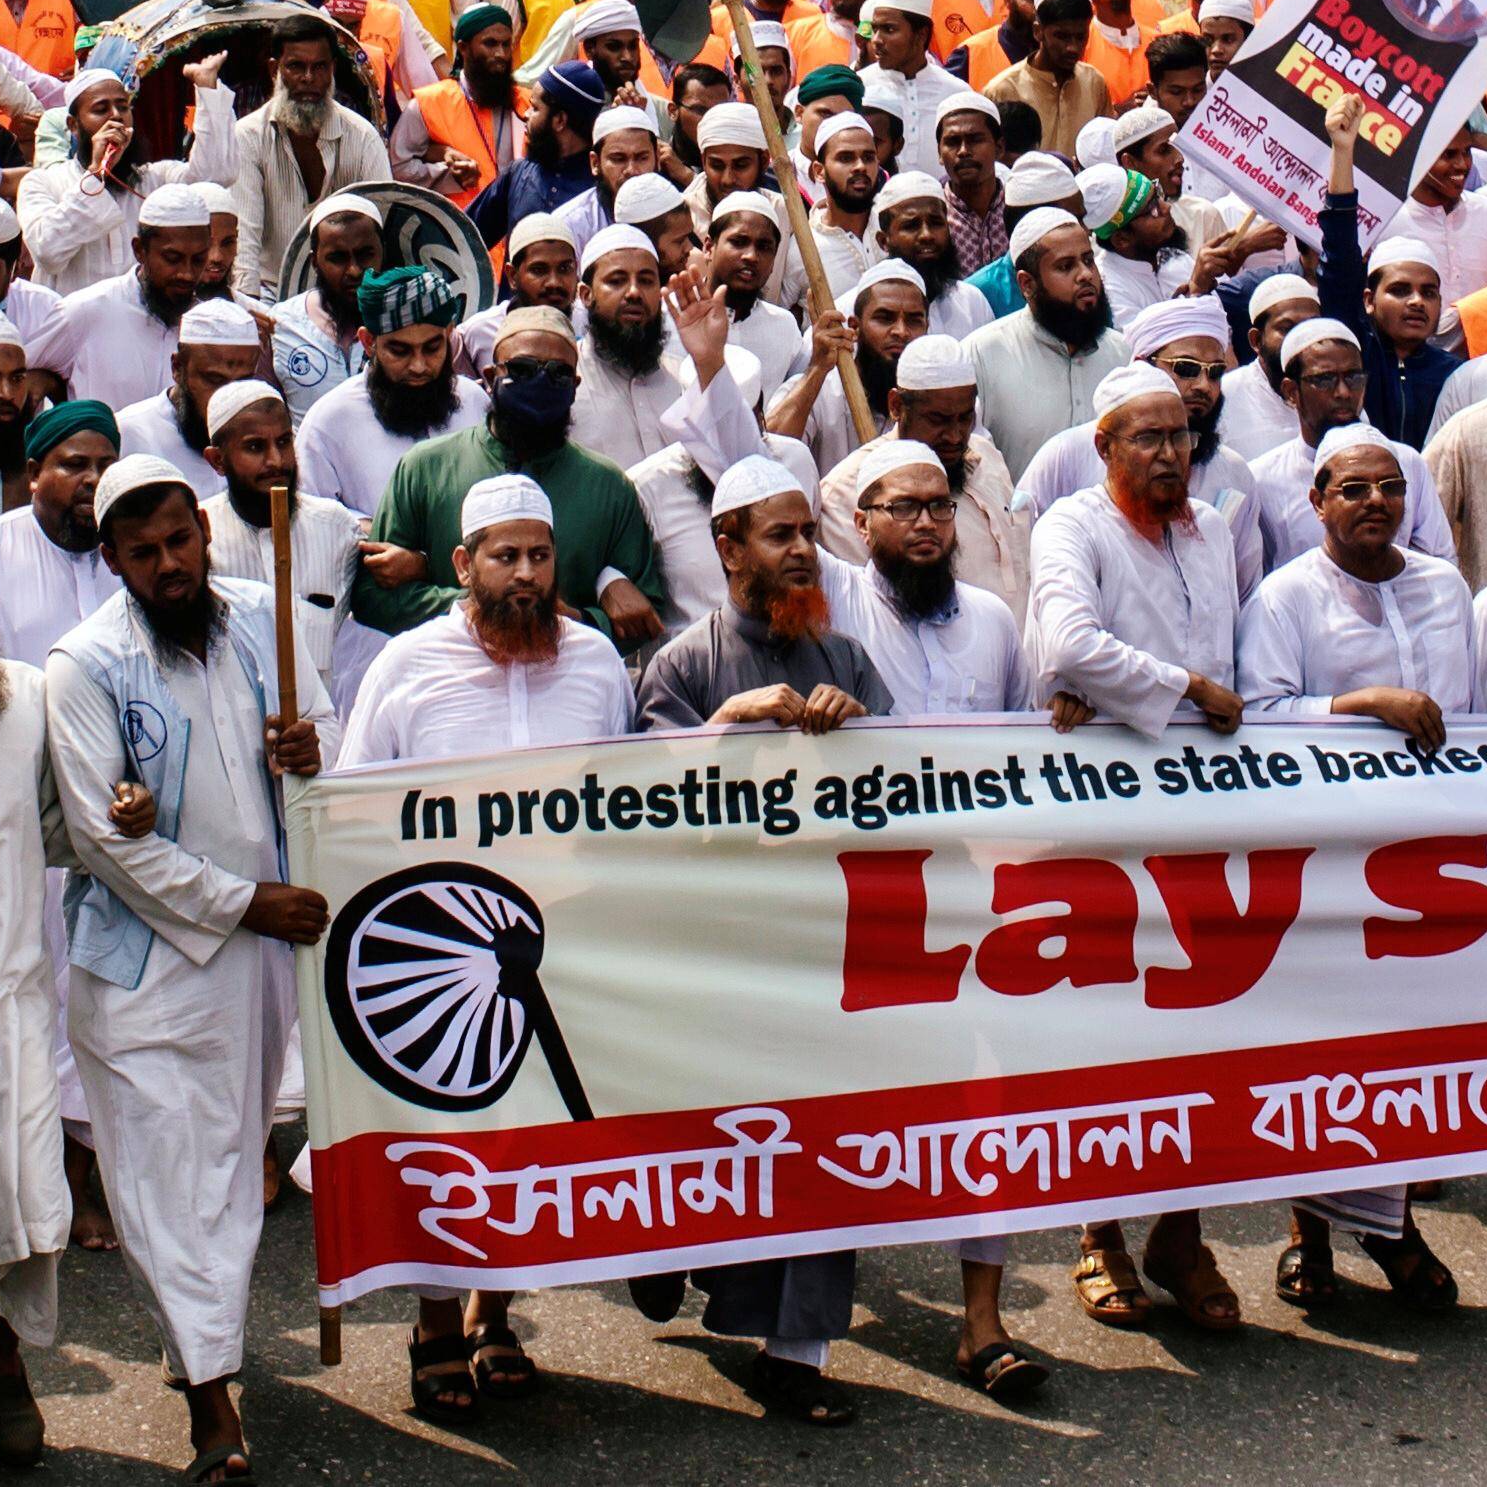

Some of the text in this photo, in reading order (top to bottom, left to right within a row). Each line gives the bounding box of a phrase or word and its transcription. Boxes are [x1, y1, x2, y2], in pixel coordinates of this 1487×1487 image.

[1275, 41, 1403, 158] Frace
[1296, 21, 1425, 128] made in
[1192, 121, 1287, 200] Islami Andolan
[1206, 86, 1322, 190] ইসলামী আন্দোলন
[400, 787, 458, 842] In
[477, 766, 802, 849] protesting
[814, 755, 1033, 834] against
[1040, 748, 1143, 806] the
[1153, 744, 1303, 799] state
[838, 846, 1316, 1012] Lay
[386, 1106, 803, 1261] ইসলামী
[817, 1092, 1216, 1200] আন্দোলন
